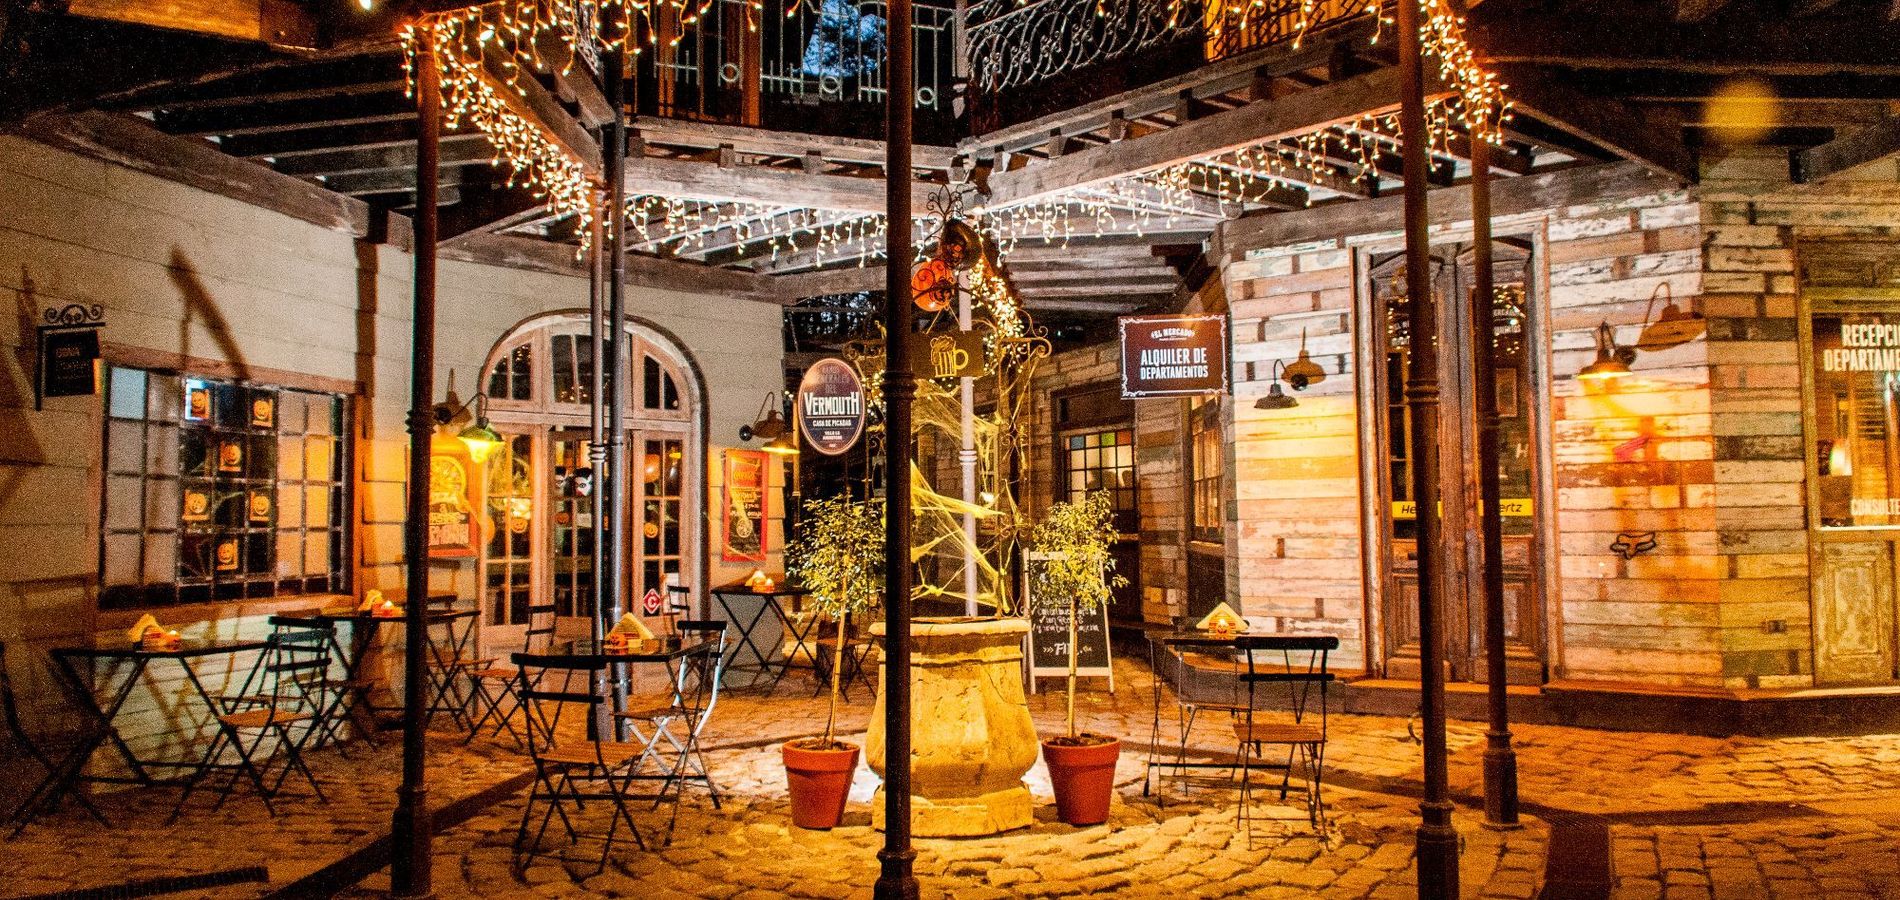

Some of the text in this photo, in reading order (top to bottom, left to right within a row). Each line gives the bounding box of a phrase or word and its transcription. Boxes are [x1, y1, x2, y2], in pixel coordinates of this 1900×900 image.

[1841, 324, 1900, 347] RECEPCI
[1141, 347, 1207, 366] ALQUILER DE
[1140, 365, 1208, 380] DEPARTAMENTOS
[803, 391, 860, 415] VERMOUTH
[825, 419, 832, 427] DE
[1499, 502, 1522, 513] ertz
